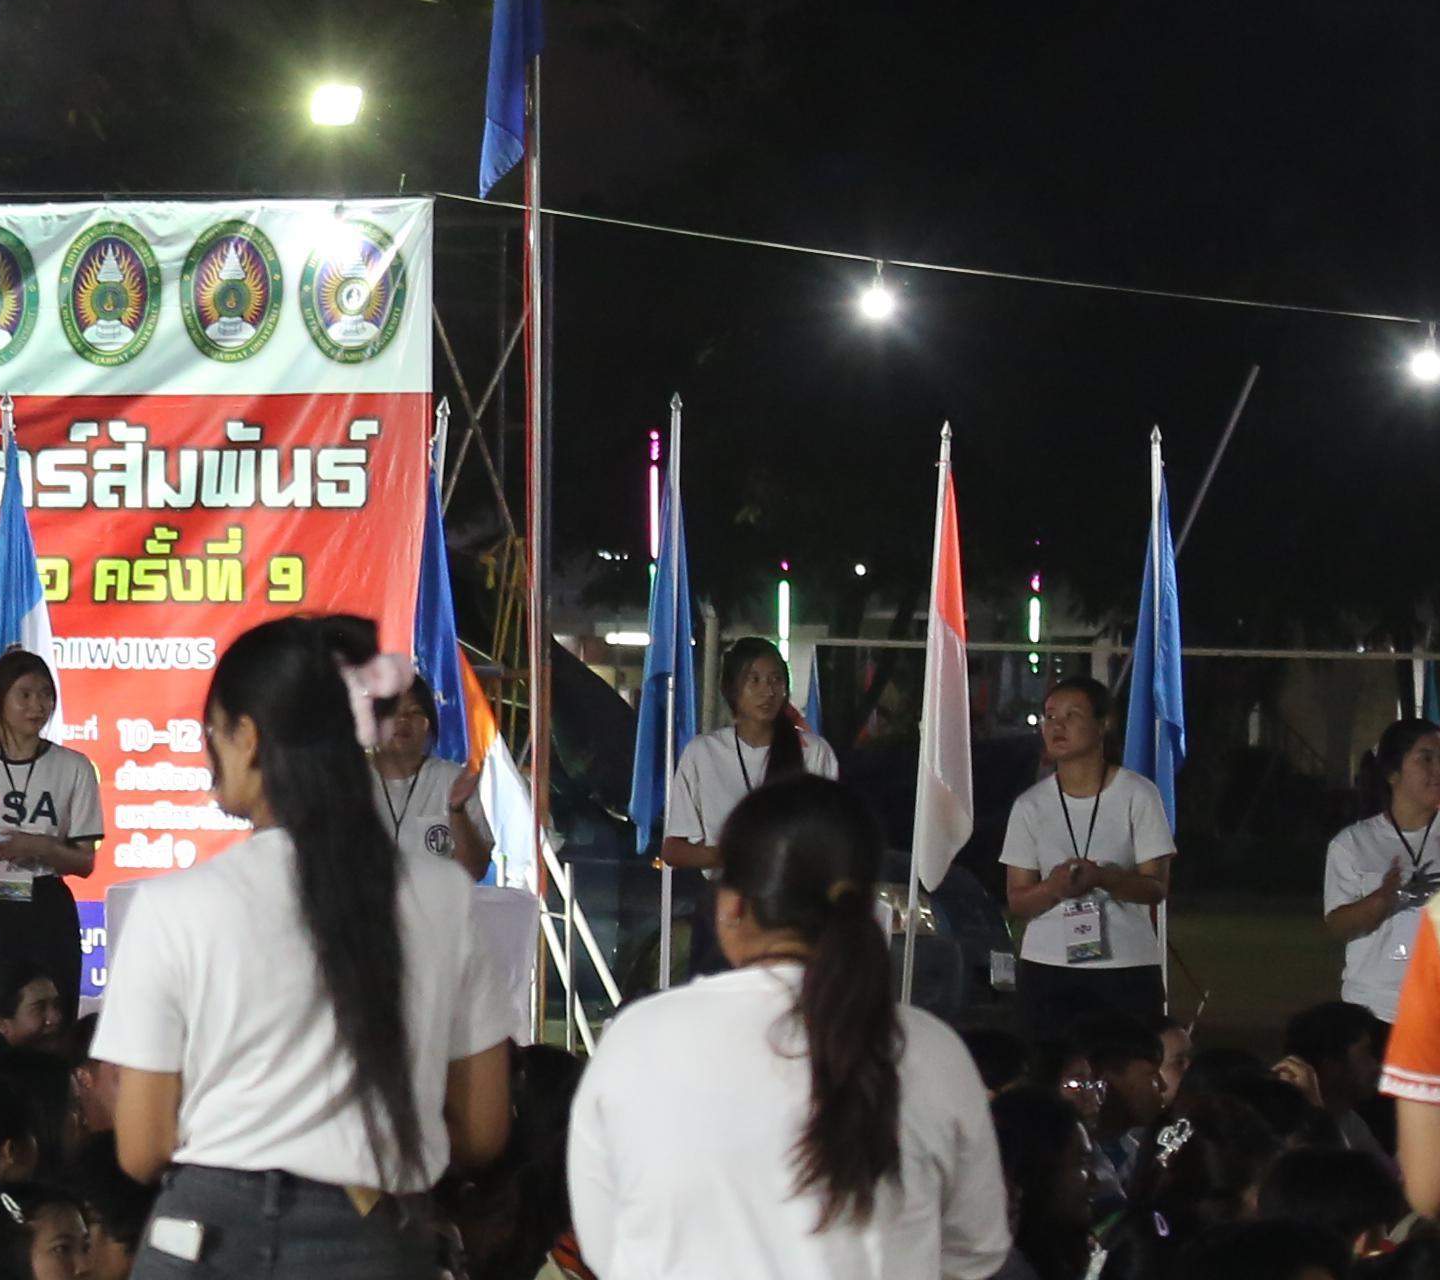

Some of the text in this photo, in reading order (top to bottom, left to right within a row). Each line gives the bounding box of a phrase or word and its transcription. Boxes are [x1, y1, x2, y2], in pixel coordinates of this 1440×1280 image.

[94, 526, 244, 603] ครั้งที่
[268, 556, 304, 603] 9
